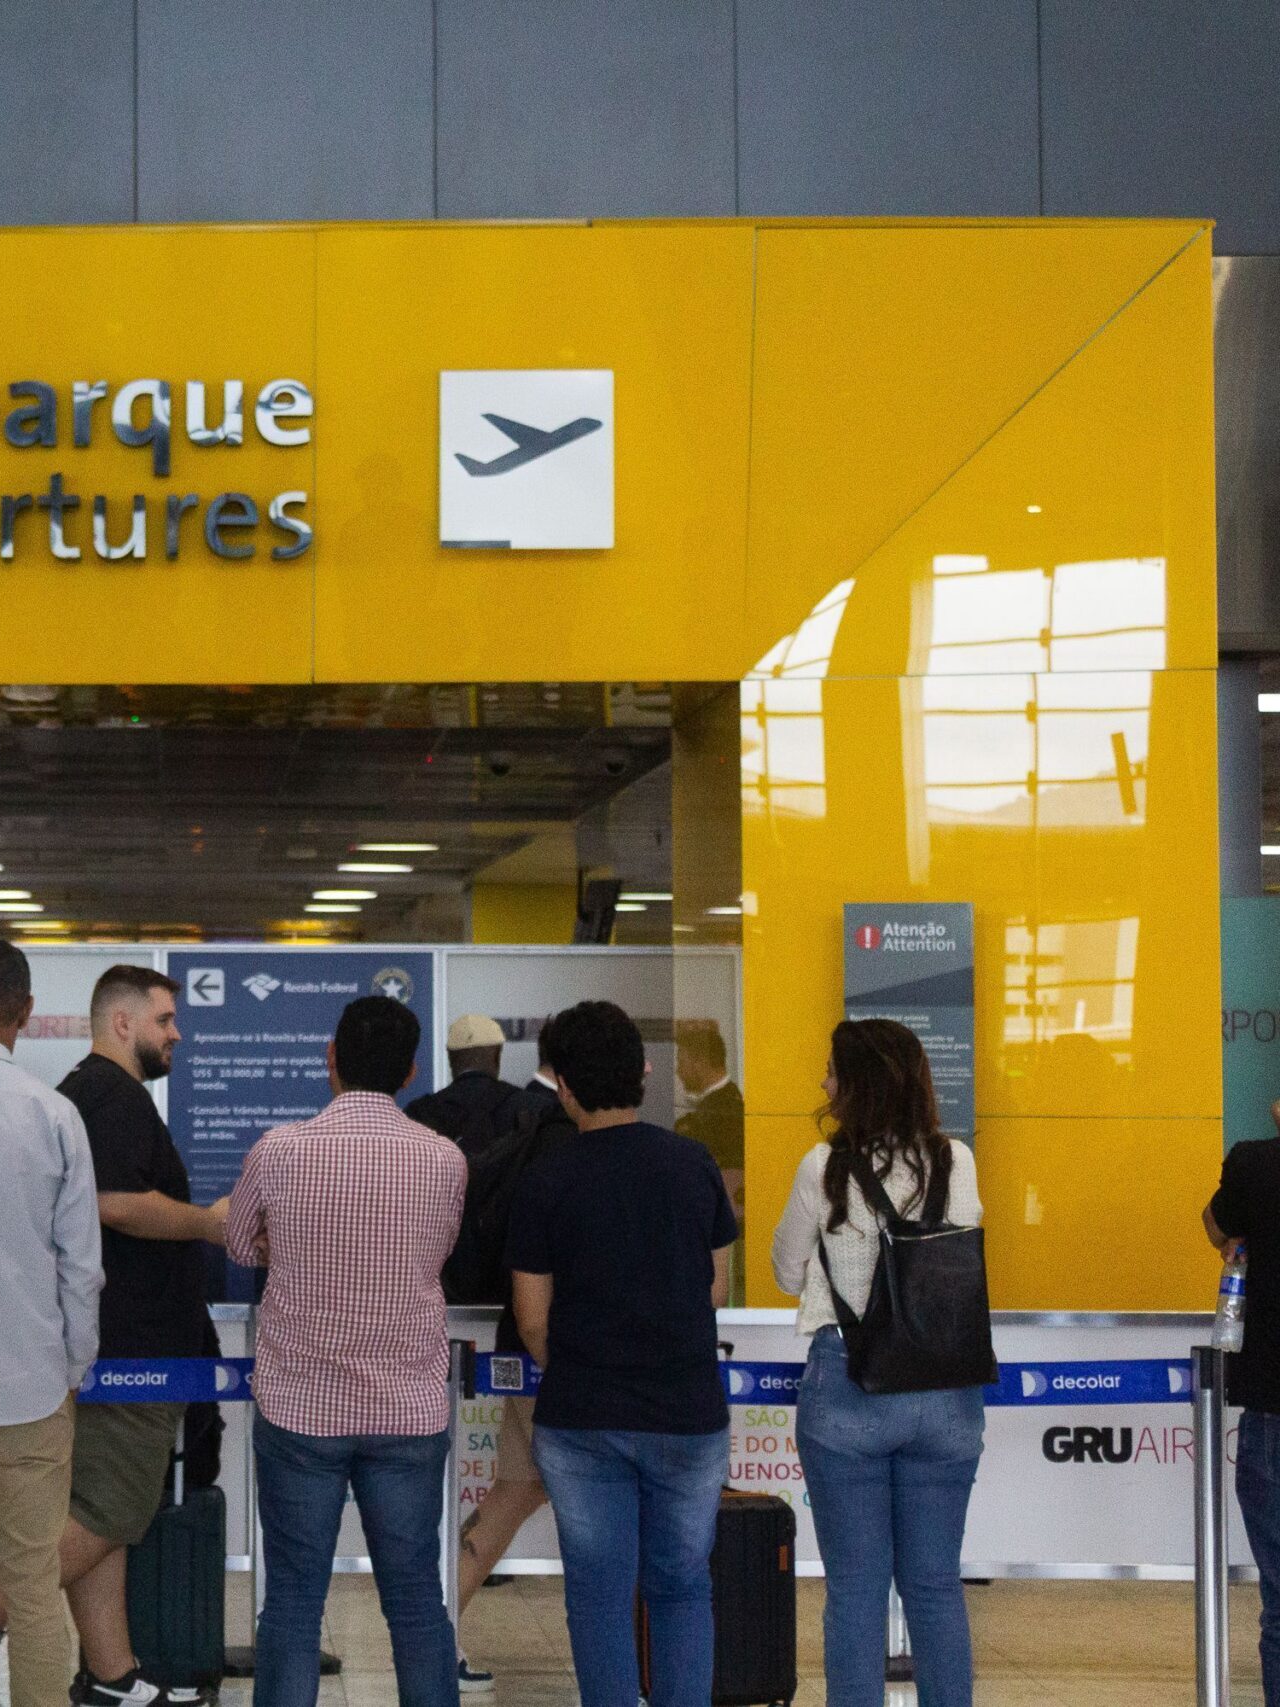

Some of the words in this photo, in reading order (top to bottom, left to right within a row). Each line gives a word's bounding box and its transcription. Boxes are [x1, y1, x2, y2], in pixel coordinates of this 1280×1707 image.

[883, 922, 946, 939] Atenção
[883, 938, 957, 951] Attention
[283, 982, 320, 993] Receita
[321, 982, 358, 993] Federal
[100, 1370, 169, 1386] decolar
[759, 1375, 803, 1389] deco
[1051, 1374, 1121, 1390] decolar
[461, 1406, 503, 1424] ULO
[745, 1406, 788, 1427] SÃO
[745, 1436, 778, 1454] DO
[728, 1463, 804, 1480] UENOS
